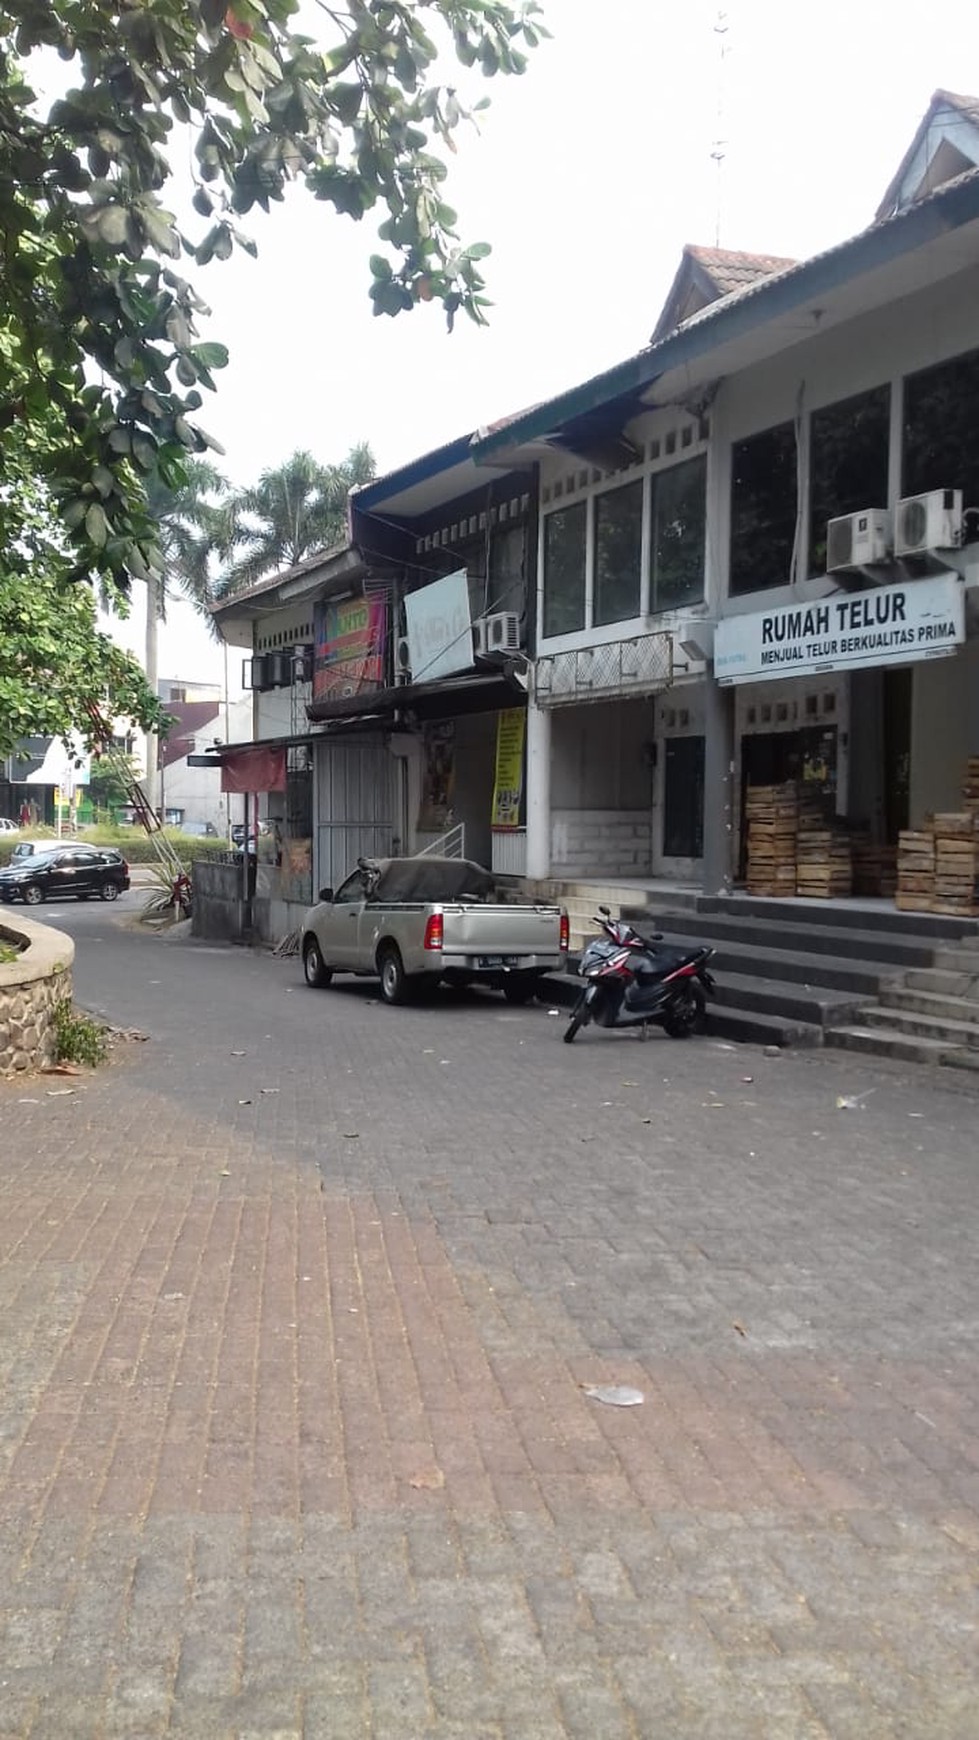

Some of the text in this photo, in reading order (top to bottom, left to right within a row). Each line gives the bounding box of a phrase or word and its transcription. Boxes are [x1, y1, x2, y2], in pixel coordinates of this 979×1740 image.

[762, 592, 906, 644] RUMAH TELUR
[761, 646, 804, 665] MENJUAL
[806, 640, 838, 658] TELUR
[841, 627, 914, 653] BERKUALITAS
[918, 621, 956, 642] PRIMA
